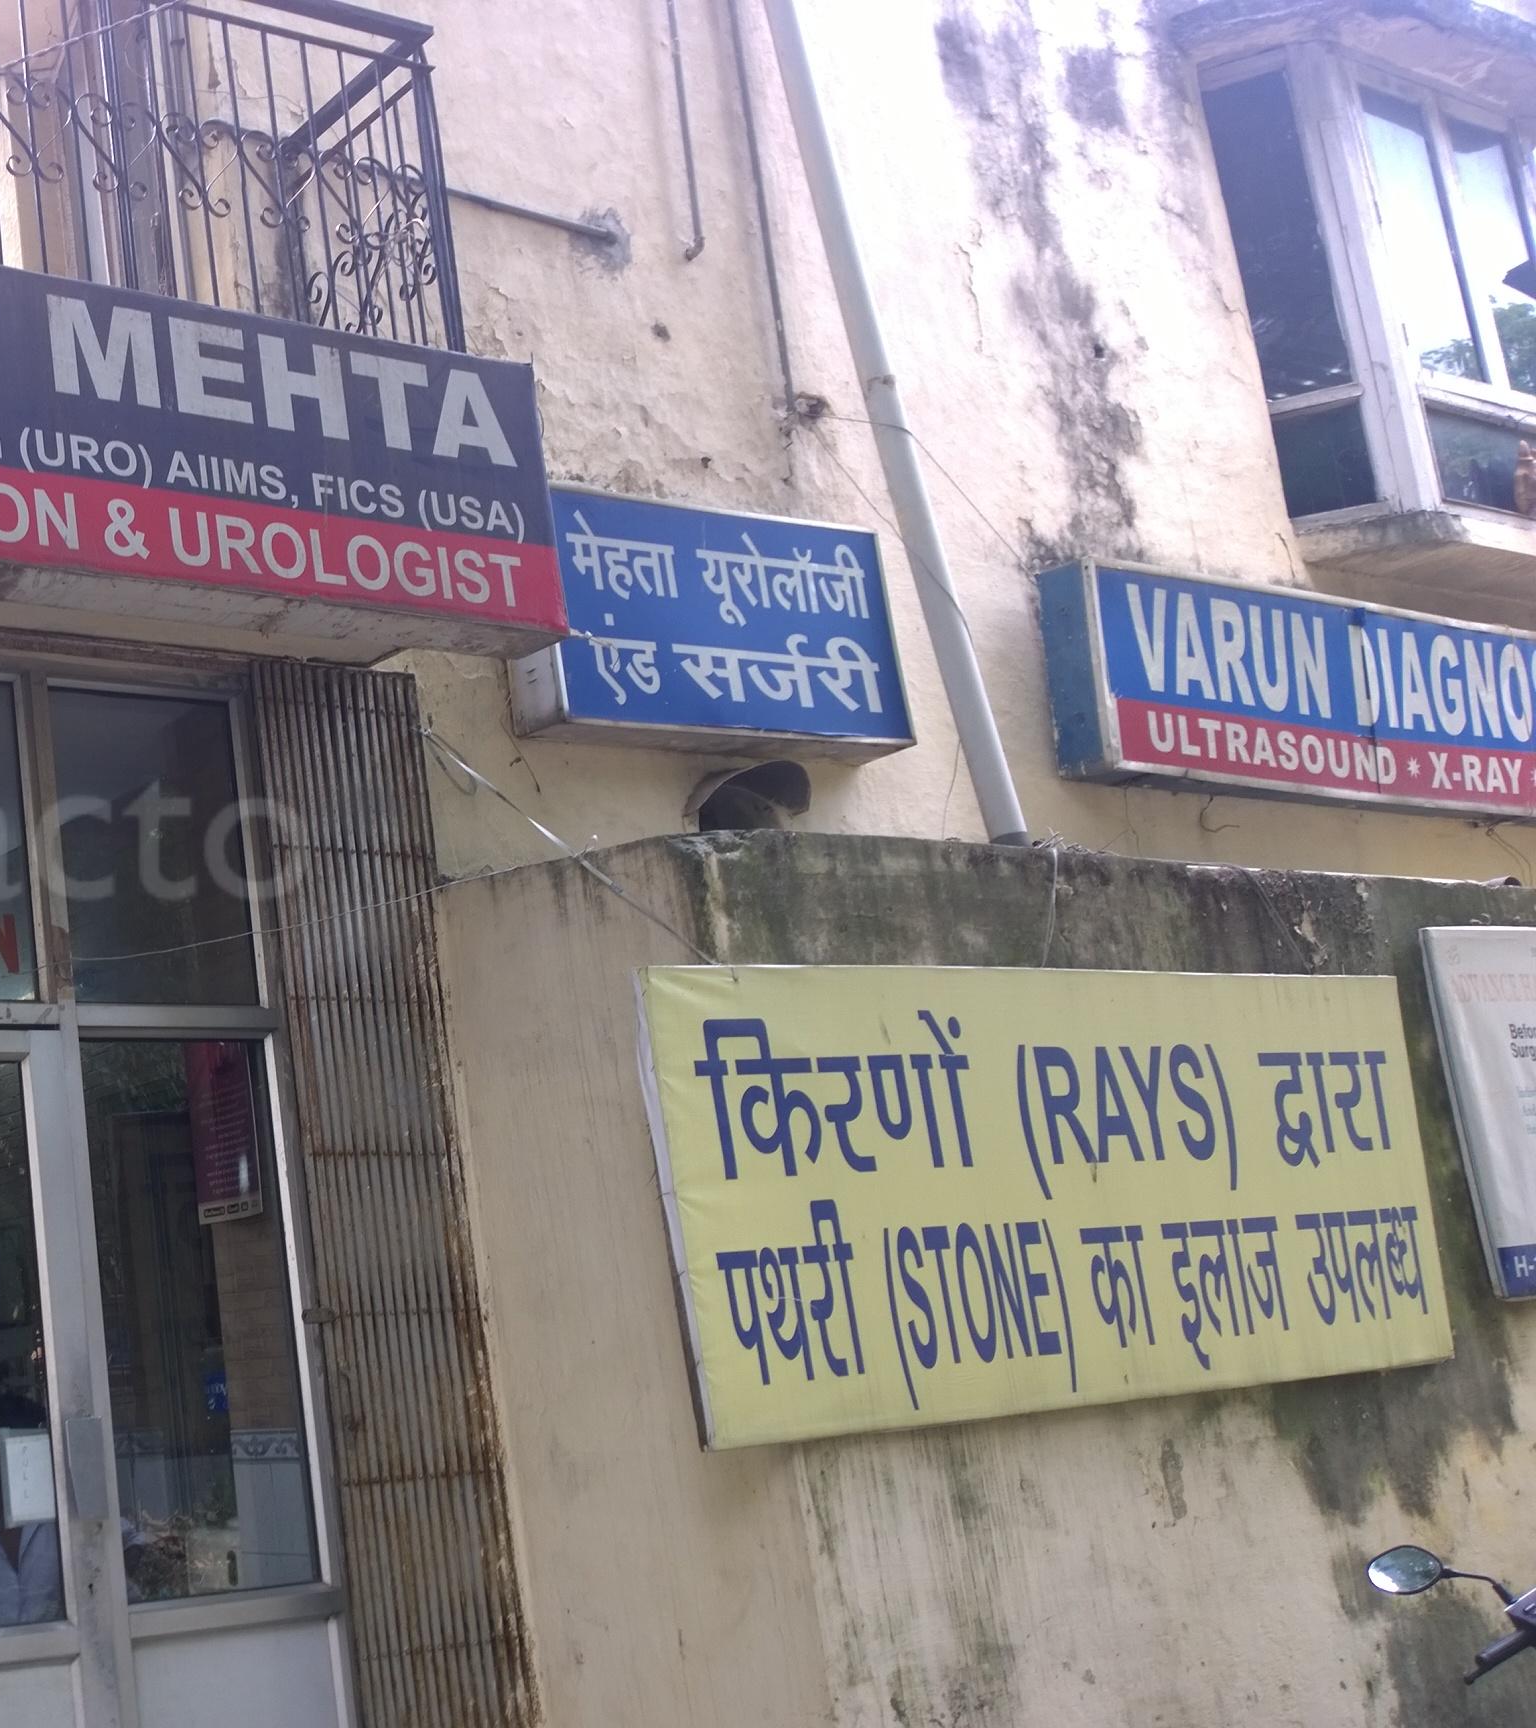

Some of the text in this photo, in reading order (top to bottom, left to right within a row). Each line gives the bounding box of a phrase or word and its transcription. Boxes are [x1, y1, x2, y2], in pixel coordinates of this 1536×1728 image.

[47, 294, 517, 467] MEHTA
[20, 427, 153, 489] (URO)
[166, 450, 299, 509] AIIMS,
[313, 472, 404, 519] FICS
[419, 488, 526, 544] (USA)
[104, 498, 151, 561] &
[169, 506, 521, 608] UROLOGIST
[566, 510, 869, 627] मेहता यूरोलॉजी
[590, 613, 883, 713] एंड सर्जरी
[1126, 583, 1536, 742] VARUN DIAGNO
[1147, 710, 1522, 795] ULTRASOUND X-RAY
[695, 1009, 1393, 1199] किरणों (RAYS) द्वारा
[716, 1200, 1427, 1410] पथरी (STONE) का इलाज उपलब्ध
